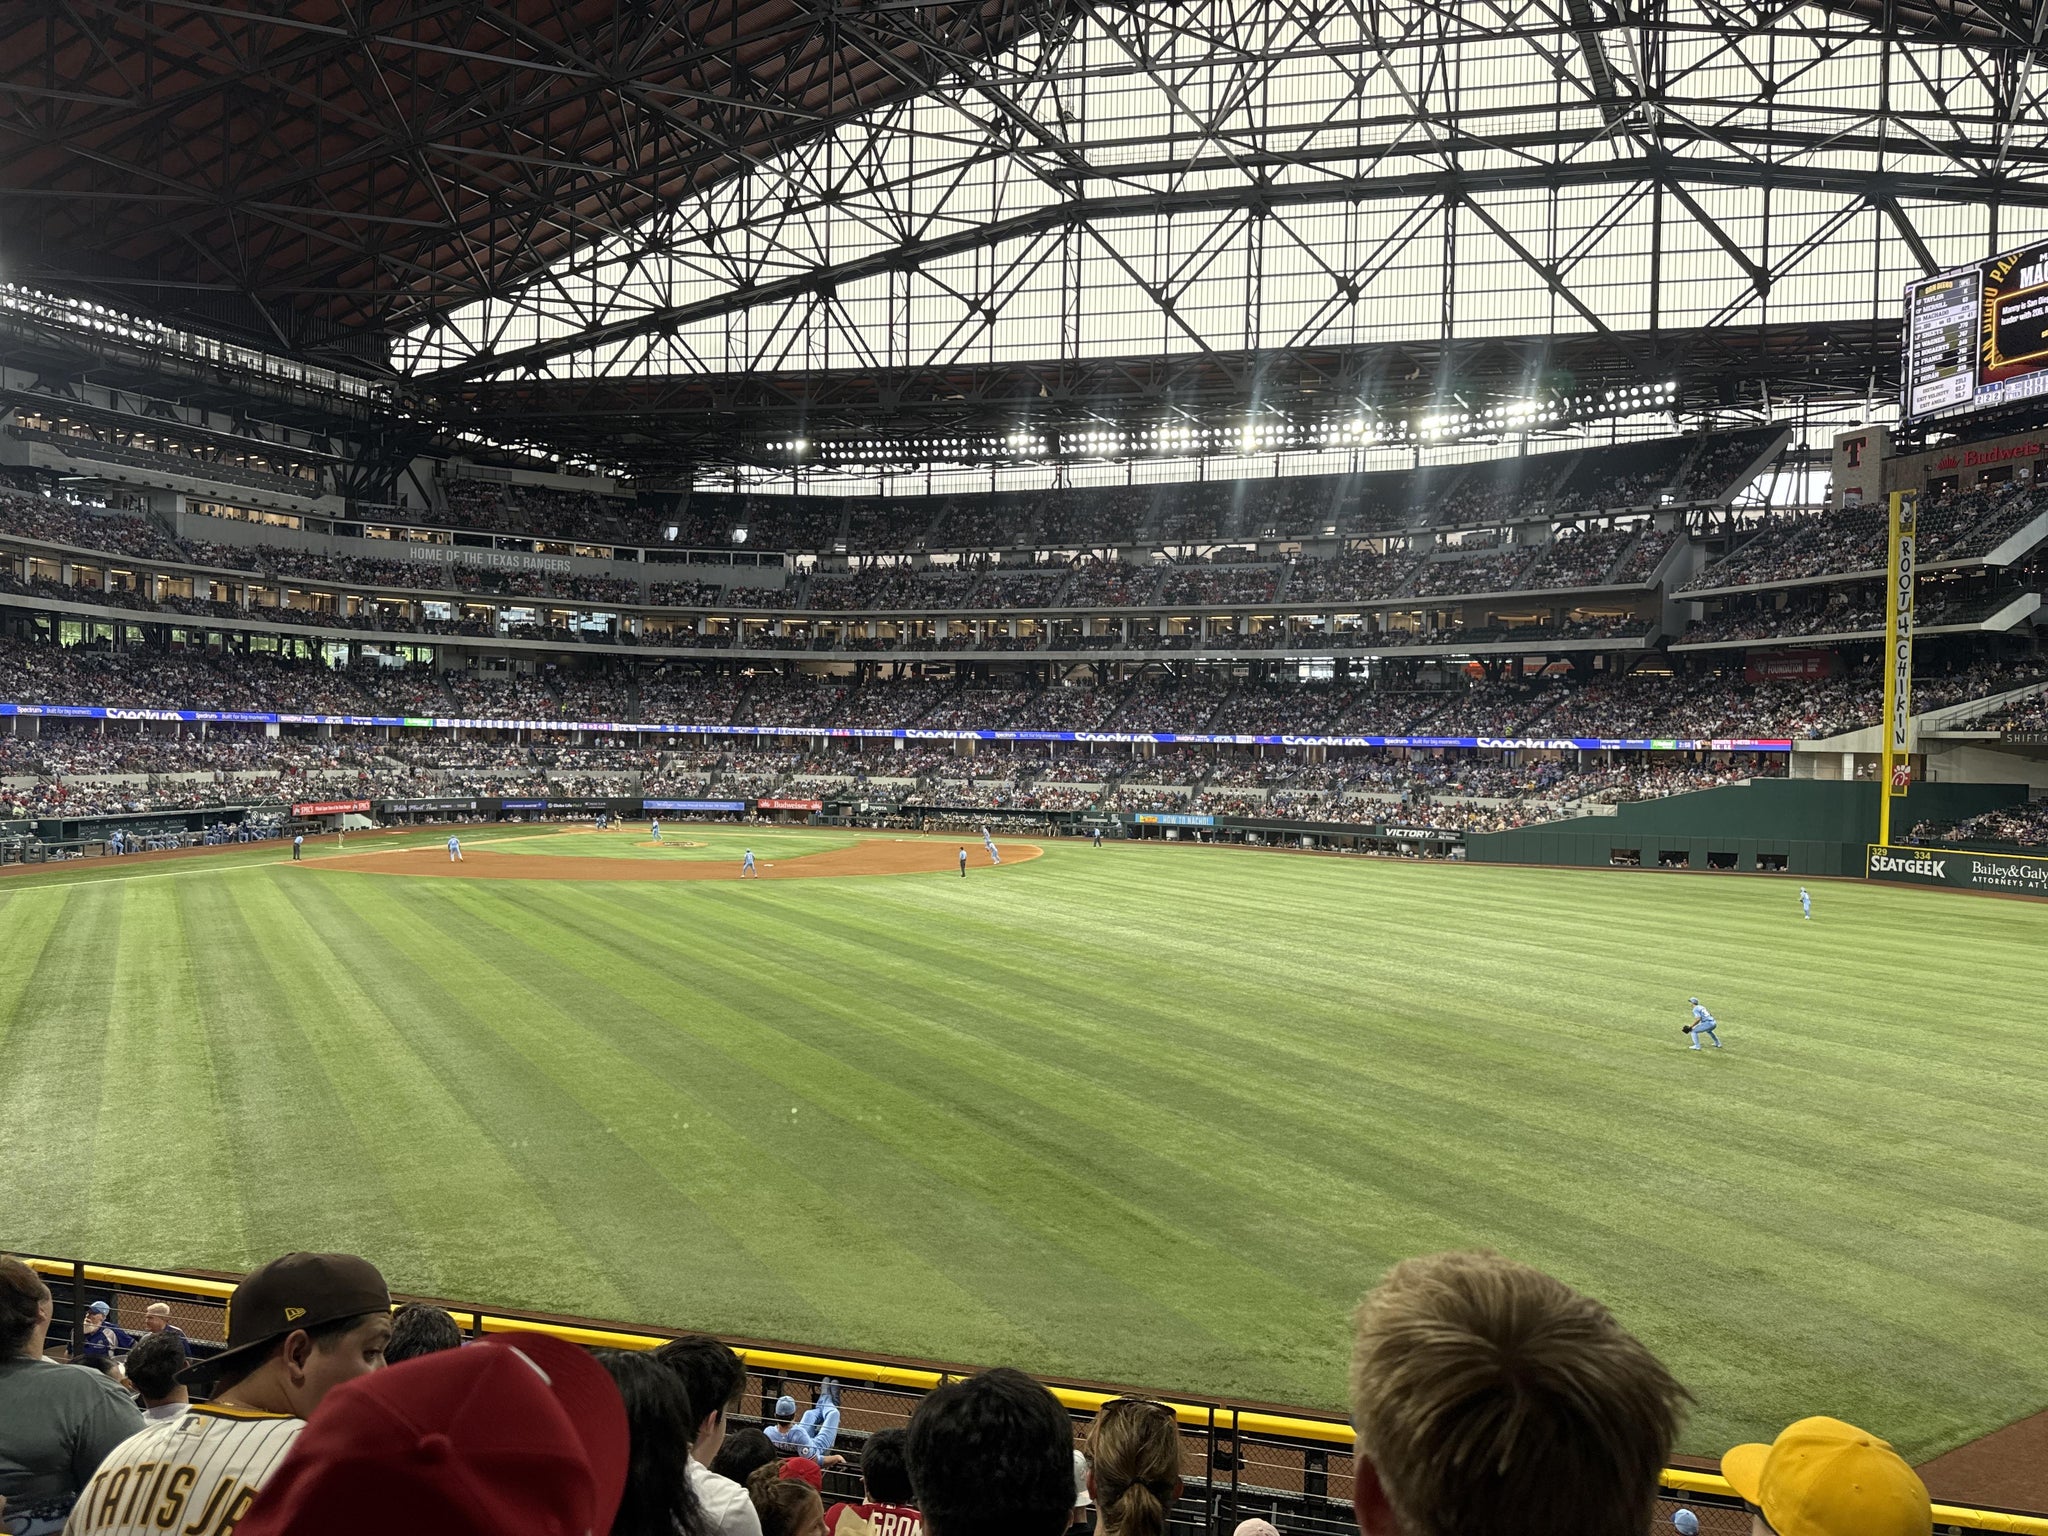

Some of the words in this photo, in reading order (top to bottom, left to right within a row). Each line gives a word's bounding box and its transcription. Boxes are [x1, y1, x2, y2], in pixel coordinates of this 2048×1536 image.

[1923, 294, 1944, 304] TAYLOR
[1923, 310, 1950, 320] MACHADO
[1842, 436, 1866, 468] T
[410, 547, 442, 561] HOME
[446, 550, 460, 562] OF
[464, 552, 484, 564] THE
[486, 554, 520, 567] TEXAS
[524, 556, 572, 572] RANGERS
[774, 801, 808, 809] Budweiser
[1163, 815, 1176, 824] HOW
[1385, 828, 1432, 838] VICTORY
[1872, 848, 1888, 857] 329
[1914, 851, 1931, 860] 334
[1870, 856, 1946, 878] SEATGEEK
[1972, 876, 2023, 887] ATTORNEYS
[85, 1463, 198, 1532] TATIS
